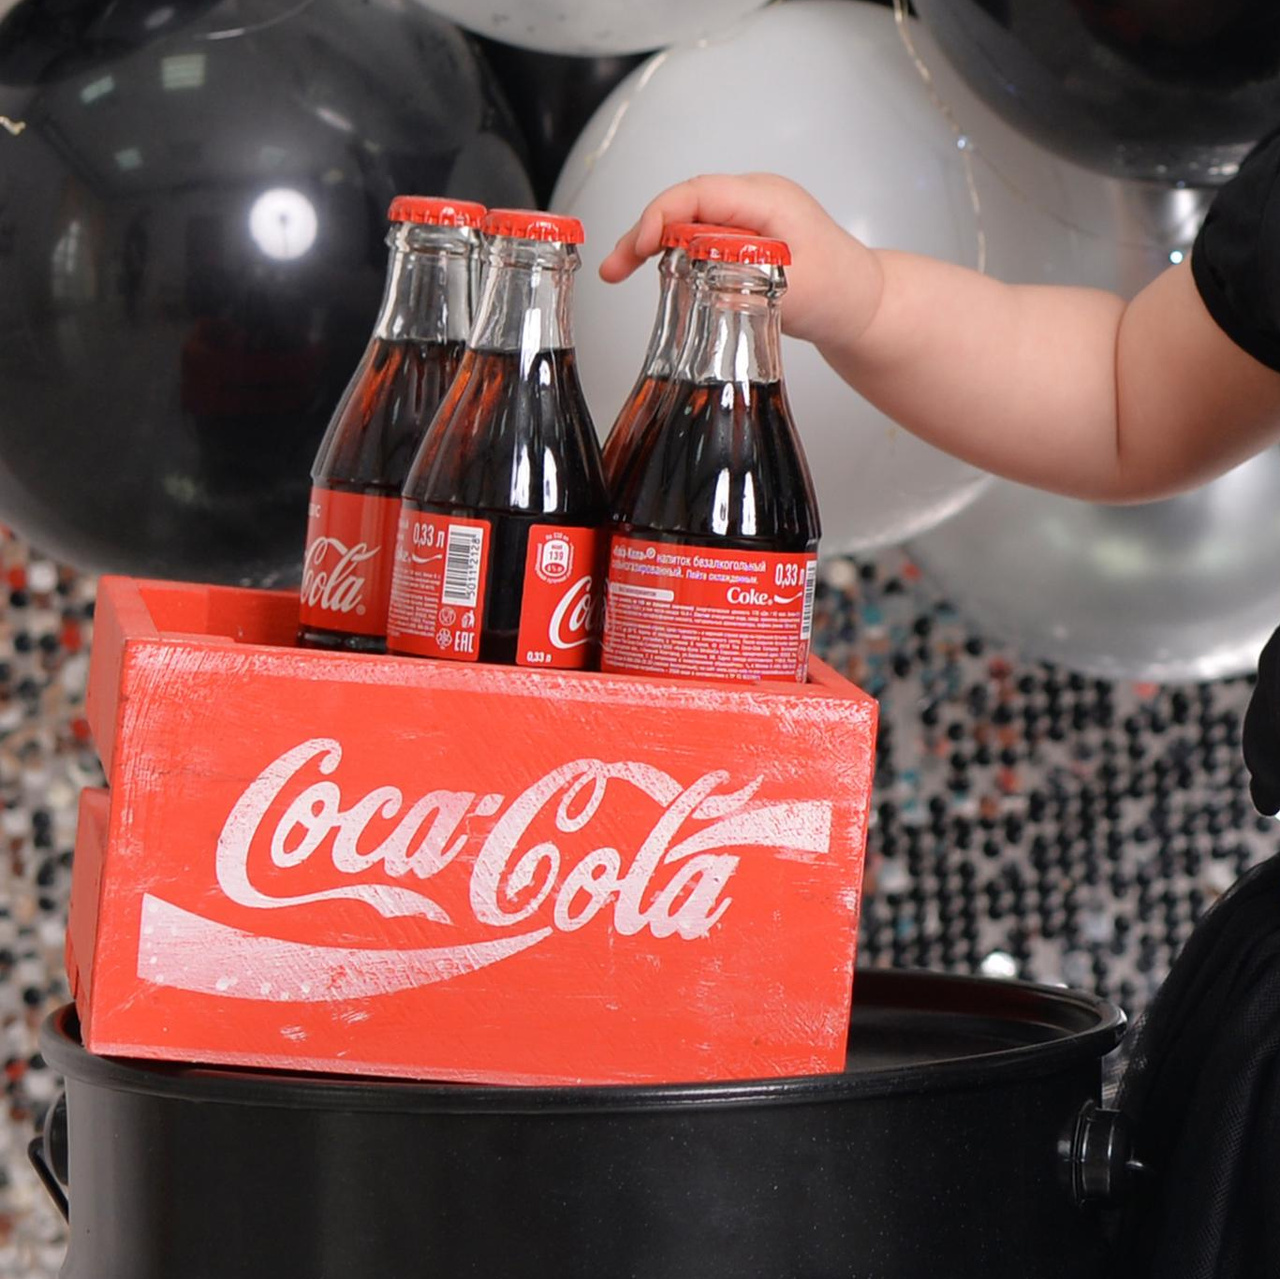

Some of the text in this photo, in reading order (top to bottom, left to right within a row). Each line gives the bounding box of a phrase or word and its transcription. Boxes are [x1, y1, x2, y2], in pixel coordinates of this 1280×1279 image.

[413, 523, 445, 549] 0,33 л
[549, 551, 564, 561] 139
[775, 563, 798, 589] 0,33
[727, 586, 769, 606] Coke
[215, 737, 764, 940] Coca-Cola
